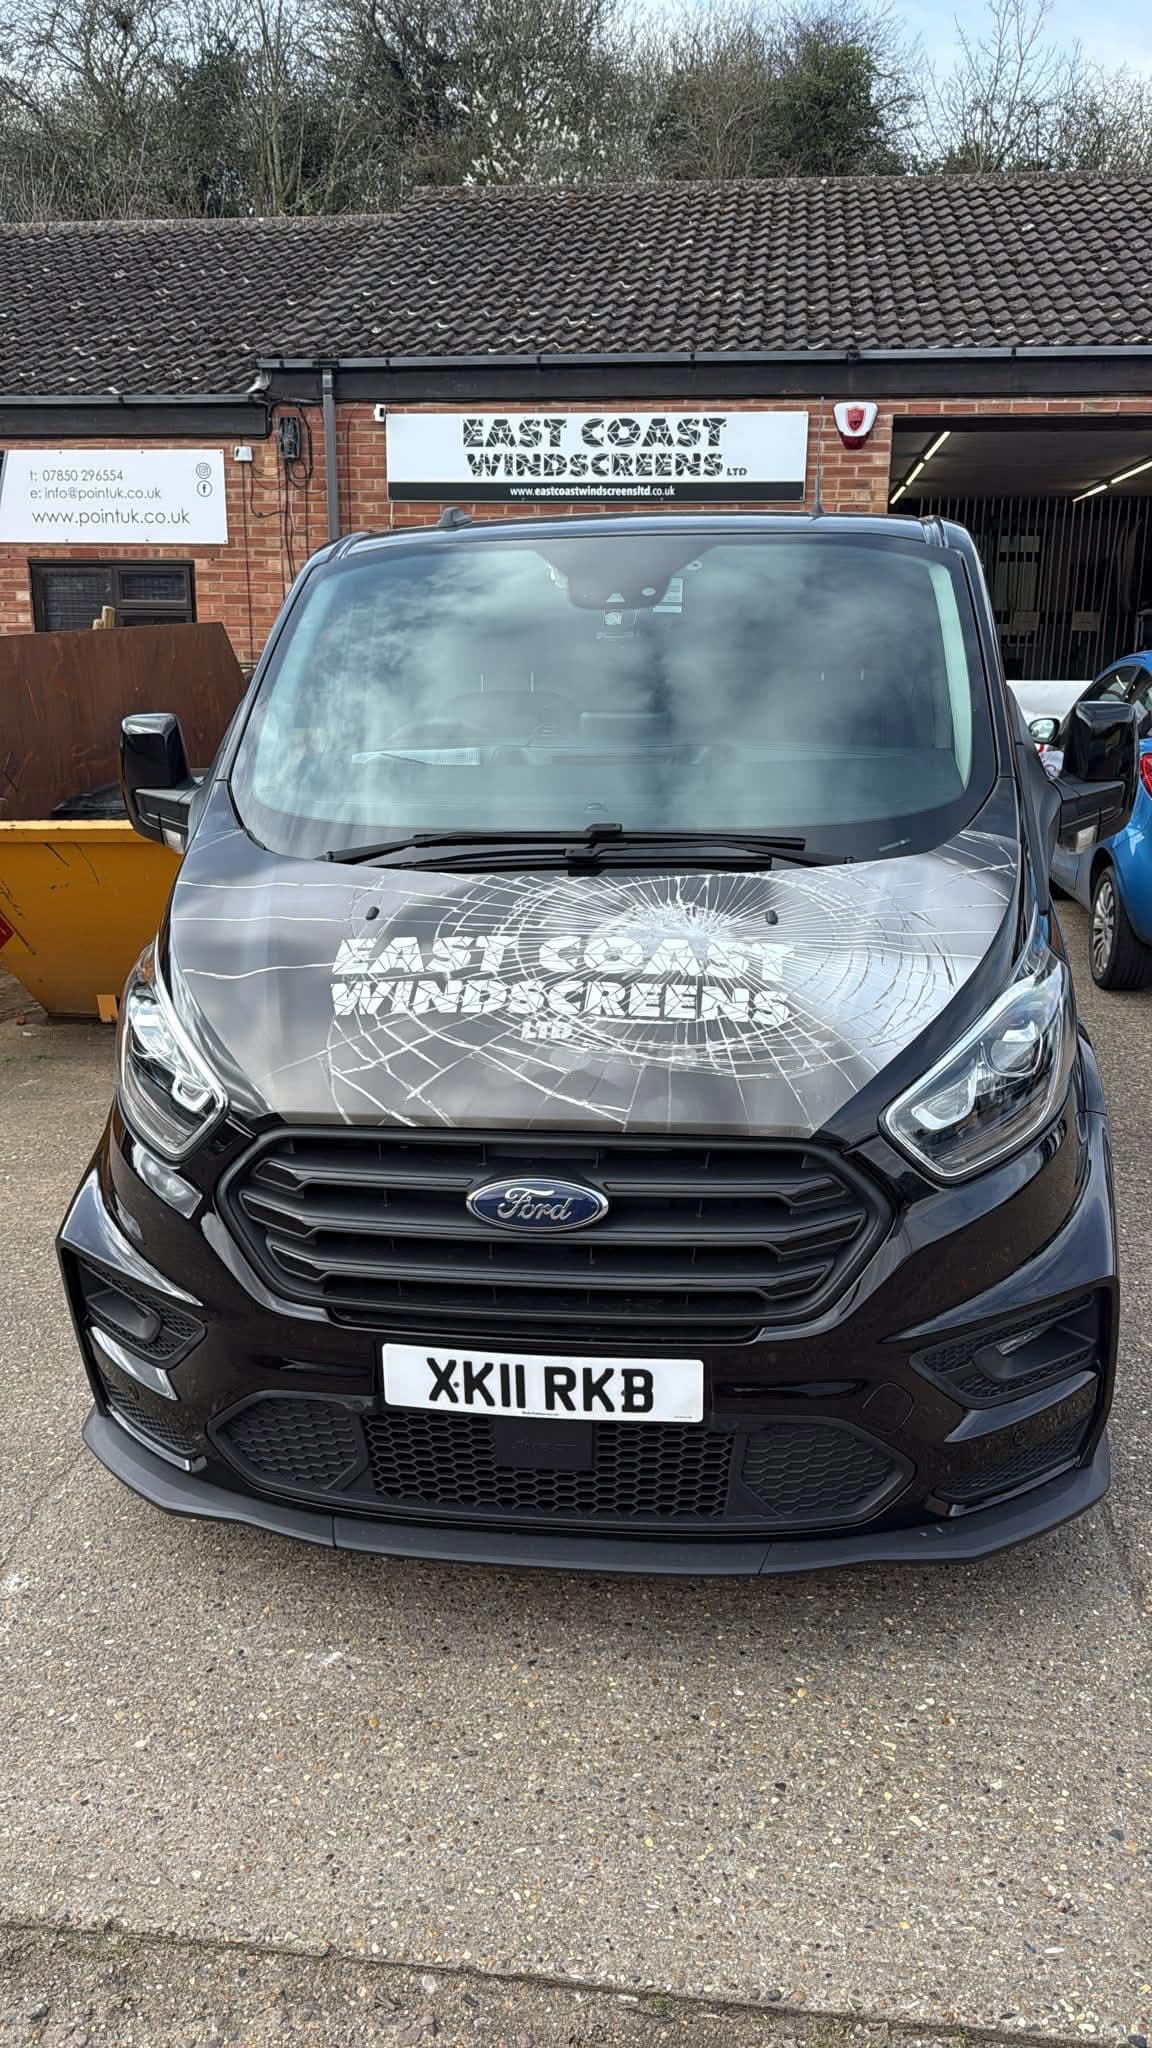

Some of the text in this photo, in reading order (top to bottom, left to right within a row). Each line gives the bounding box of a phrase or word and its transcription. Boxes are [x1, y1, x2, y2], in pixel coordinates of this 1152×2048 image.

[463, 418, 727, 448] EAST COAST
[29, 469, 124, 482] t: 07850 296554
[466, 453, 748, 477] WINDSCREENS LTD
[29, 486, 162, 501] e: info@pointuk.co.uk
[509, 485, 676, 497] www.eastcoastwindscreensltd.co.uk
[32, 508, 191, 526] www.pointuk.co.uk
[331, 935, 797, 981] EAST COAST
[330, 979, 794, 1026] WINDSCREENS
[520, 1020, 573, 1040] LTD
[497, 1187, 572, 1221] Ford
[426, 1357, 655, 1413] XK11 RKB
